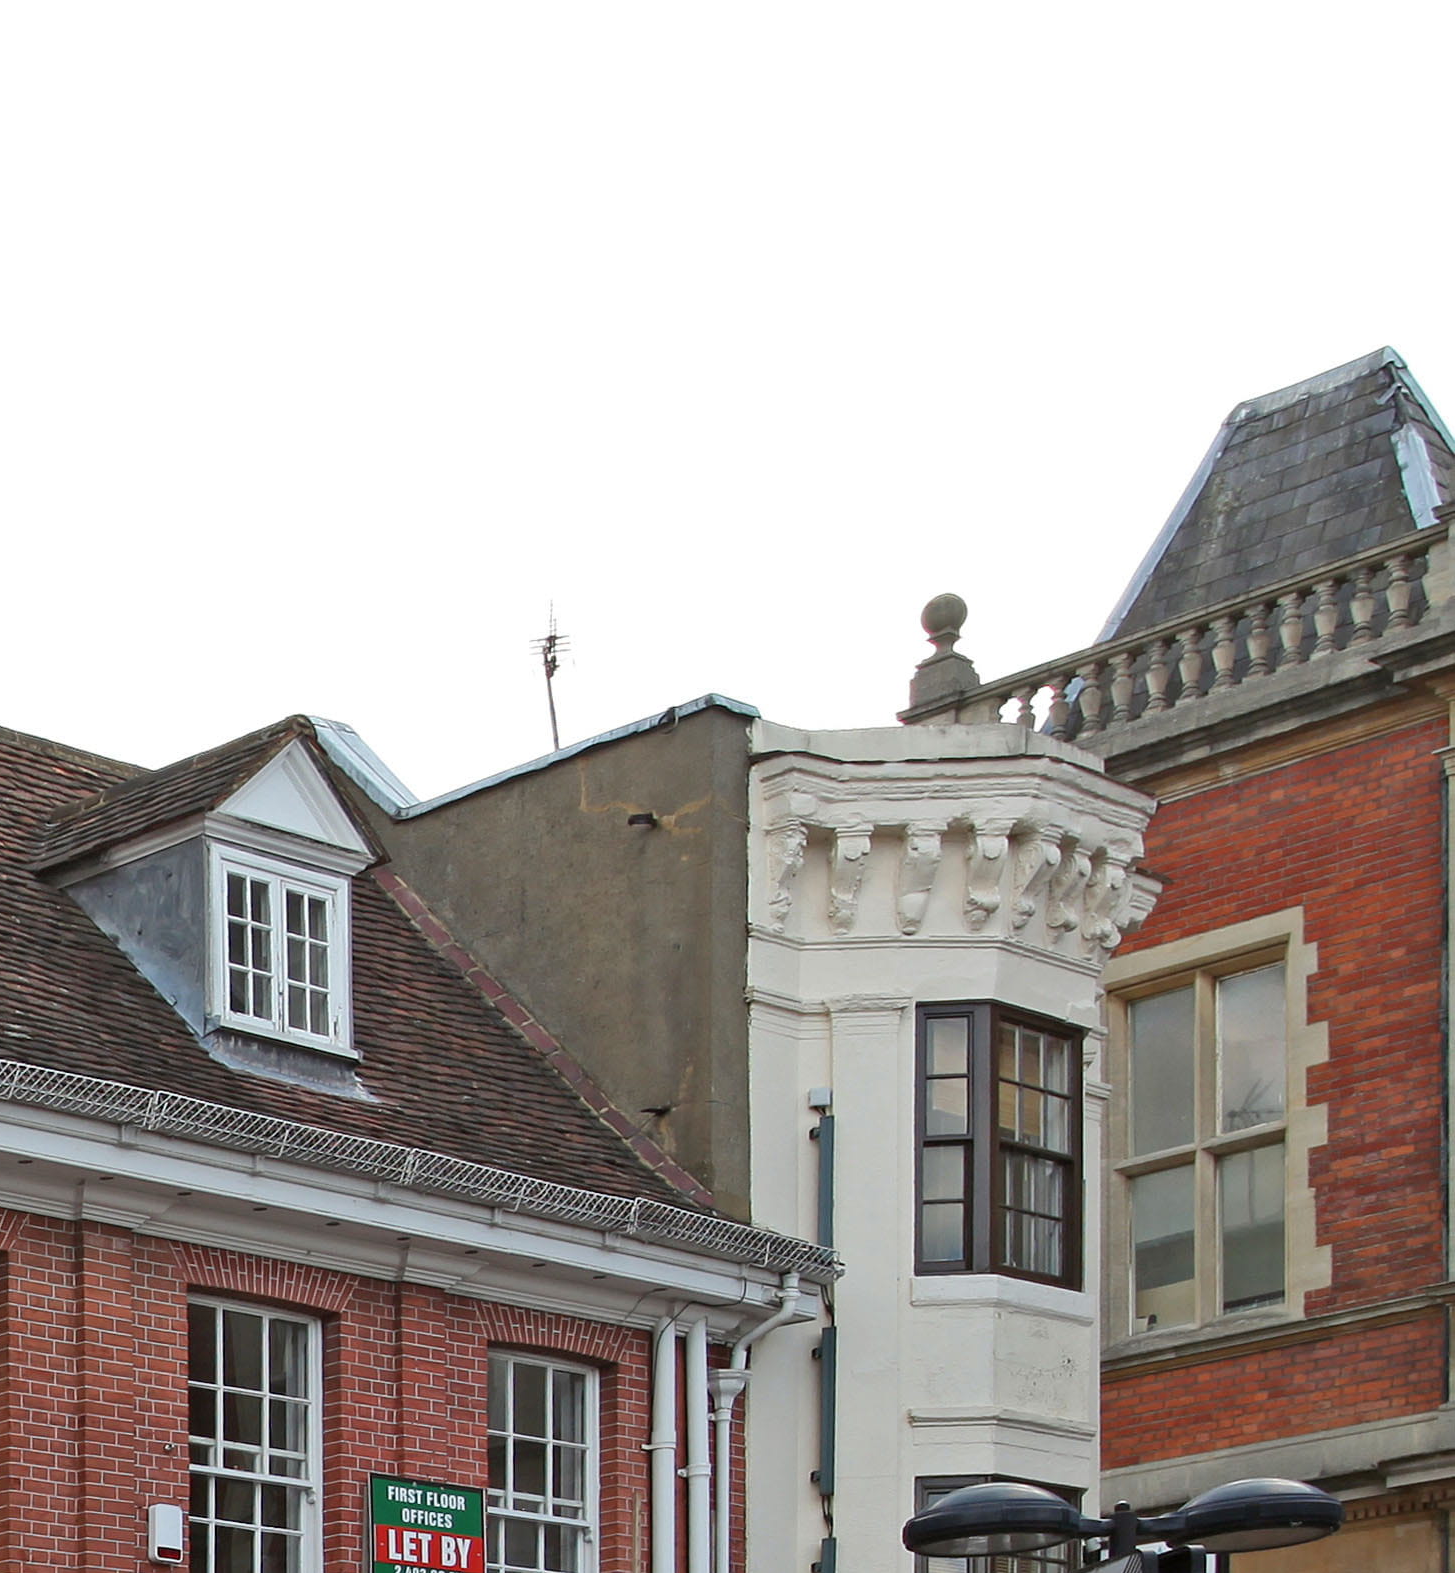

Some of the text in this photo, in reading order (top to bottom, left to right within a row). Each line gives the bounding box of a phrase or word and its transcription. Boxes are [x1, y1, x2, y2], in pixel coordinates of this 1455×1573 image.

[388, 1485, 465, 1511] FIRST FLOOR
[402, 1508, 452, 1529] OFFICES
[388, 1528, 472, 1569] LET BY
